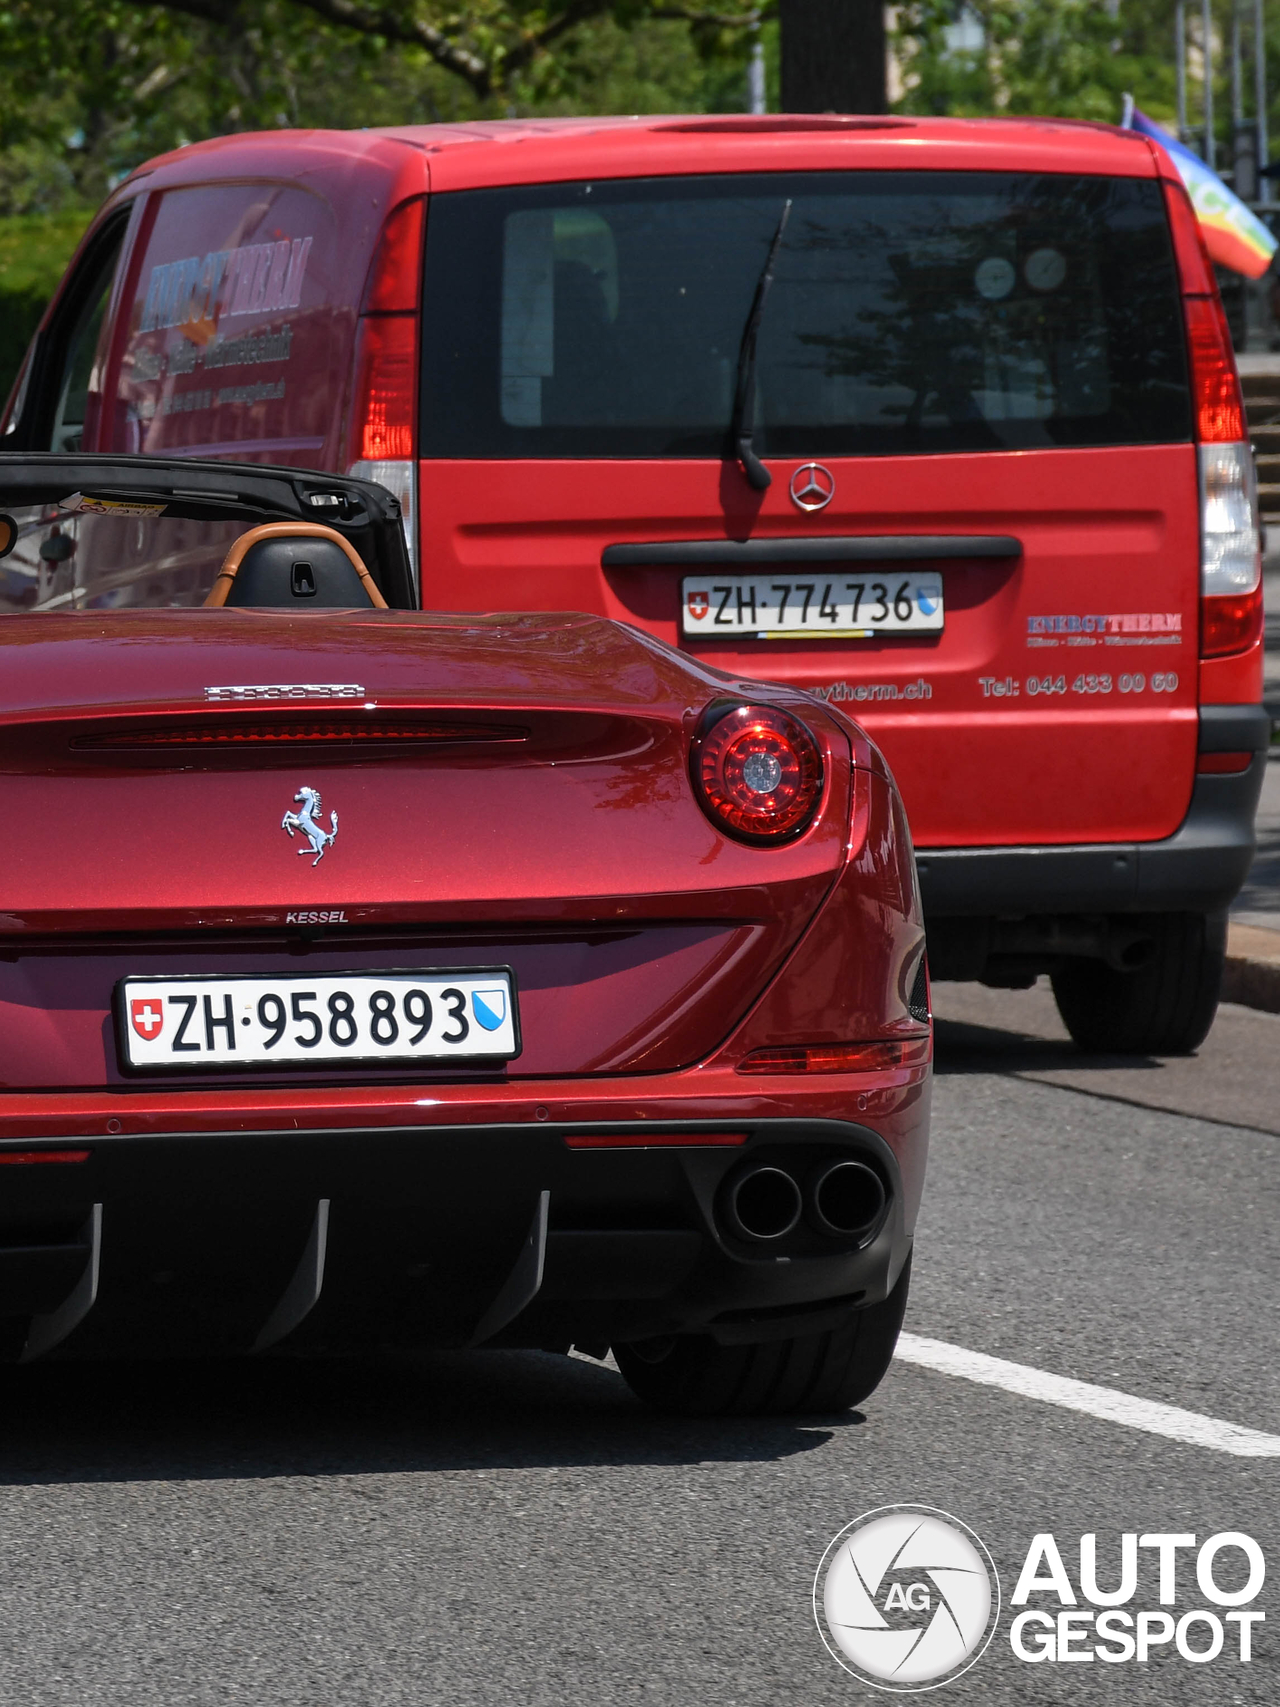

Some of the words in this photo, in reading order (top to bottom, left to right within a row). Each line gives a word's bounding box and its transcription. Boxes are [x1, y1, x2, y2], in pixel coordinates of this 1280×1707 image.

[1027, 613, 1182, 634] ENERGYTHERM
[978, 676, 1020, 697] Tel:
[1026, 674, 1067, 696] 044
[1072, 673, 1113, 694] 433
[1118, 672, 1146, 693] 00
[1151, 671, 1179, 692] 60
[286, 911, 349, 924] KESSEL
